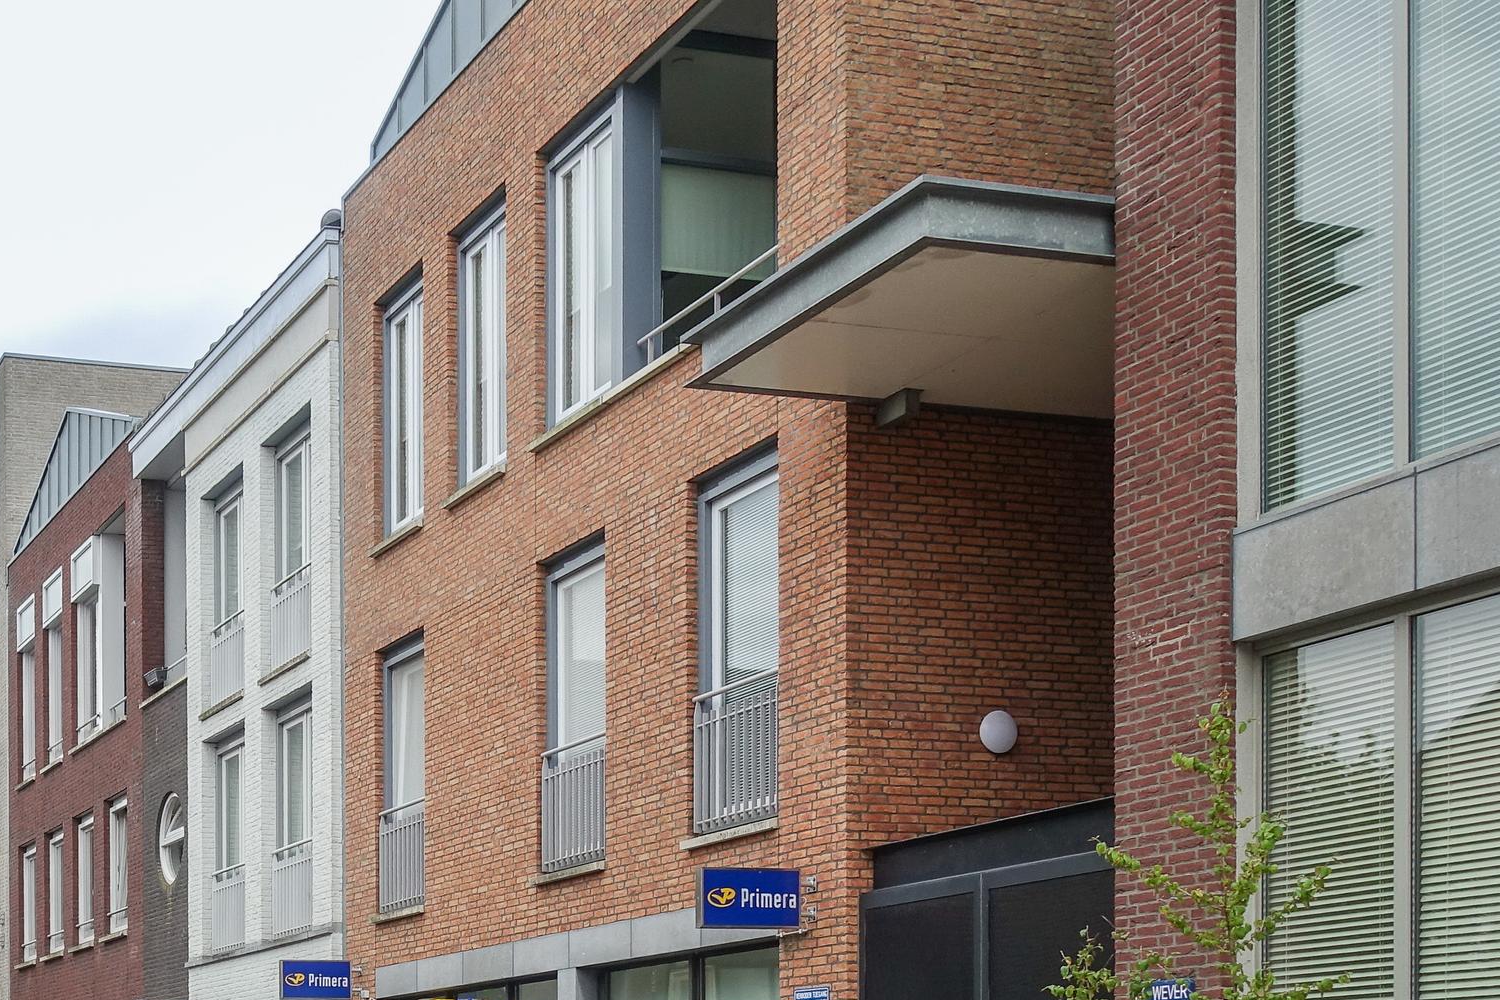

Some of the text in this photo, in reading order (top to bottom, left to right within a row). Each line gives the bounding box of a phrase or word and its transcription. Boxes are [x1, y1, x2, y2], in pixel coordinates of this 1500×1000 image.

[741, 888, 797, 909] Primera
[308, 973, 348, 988] Primera
[1152, 984, 1188, 1000] WEVER
